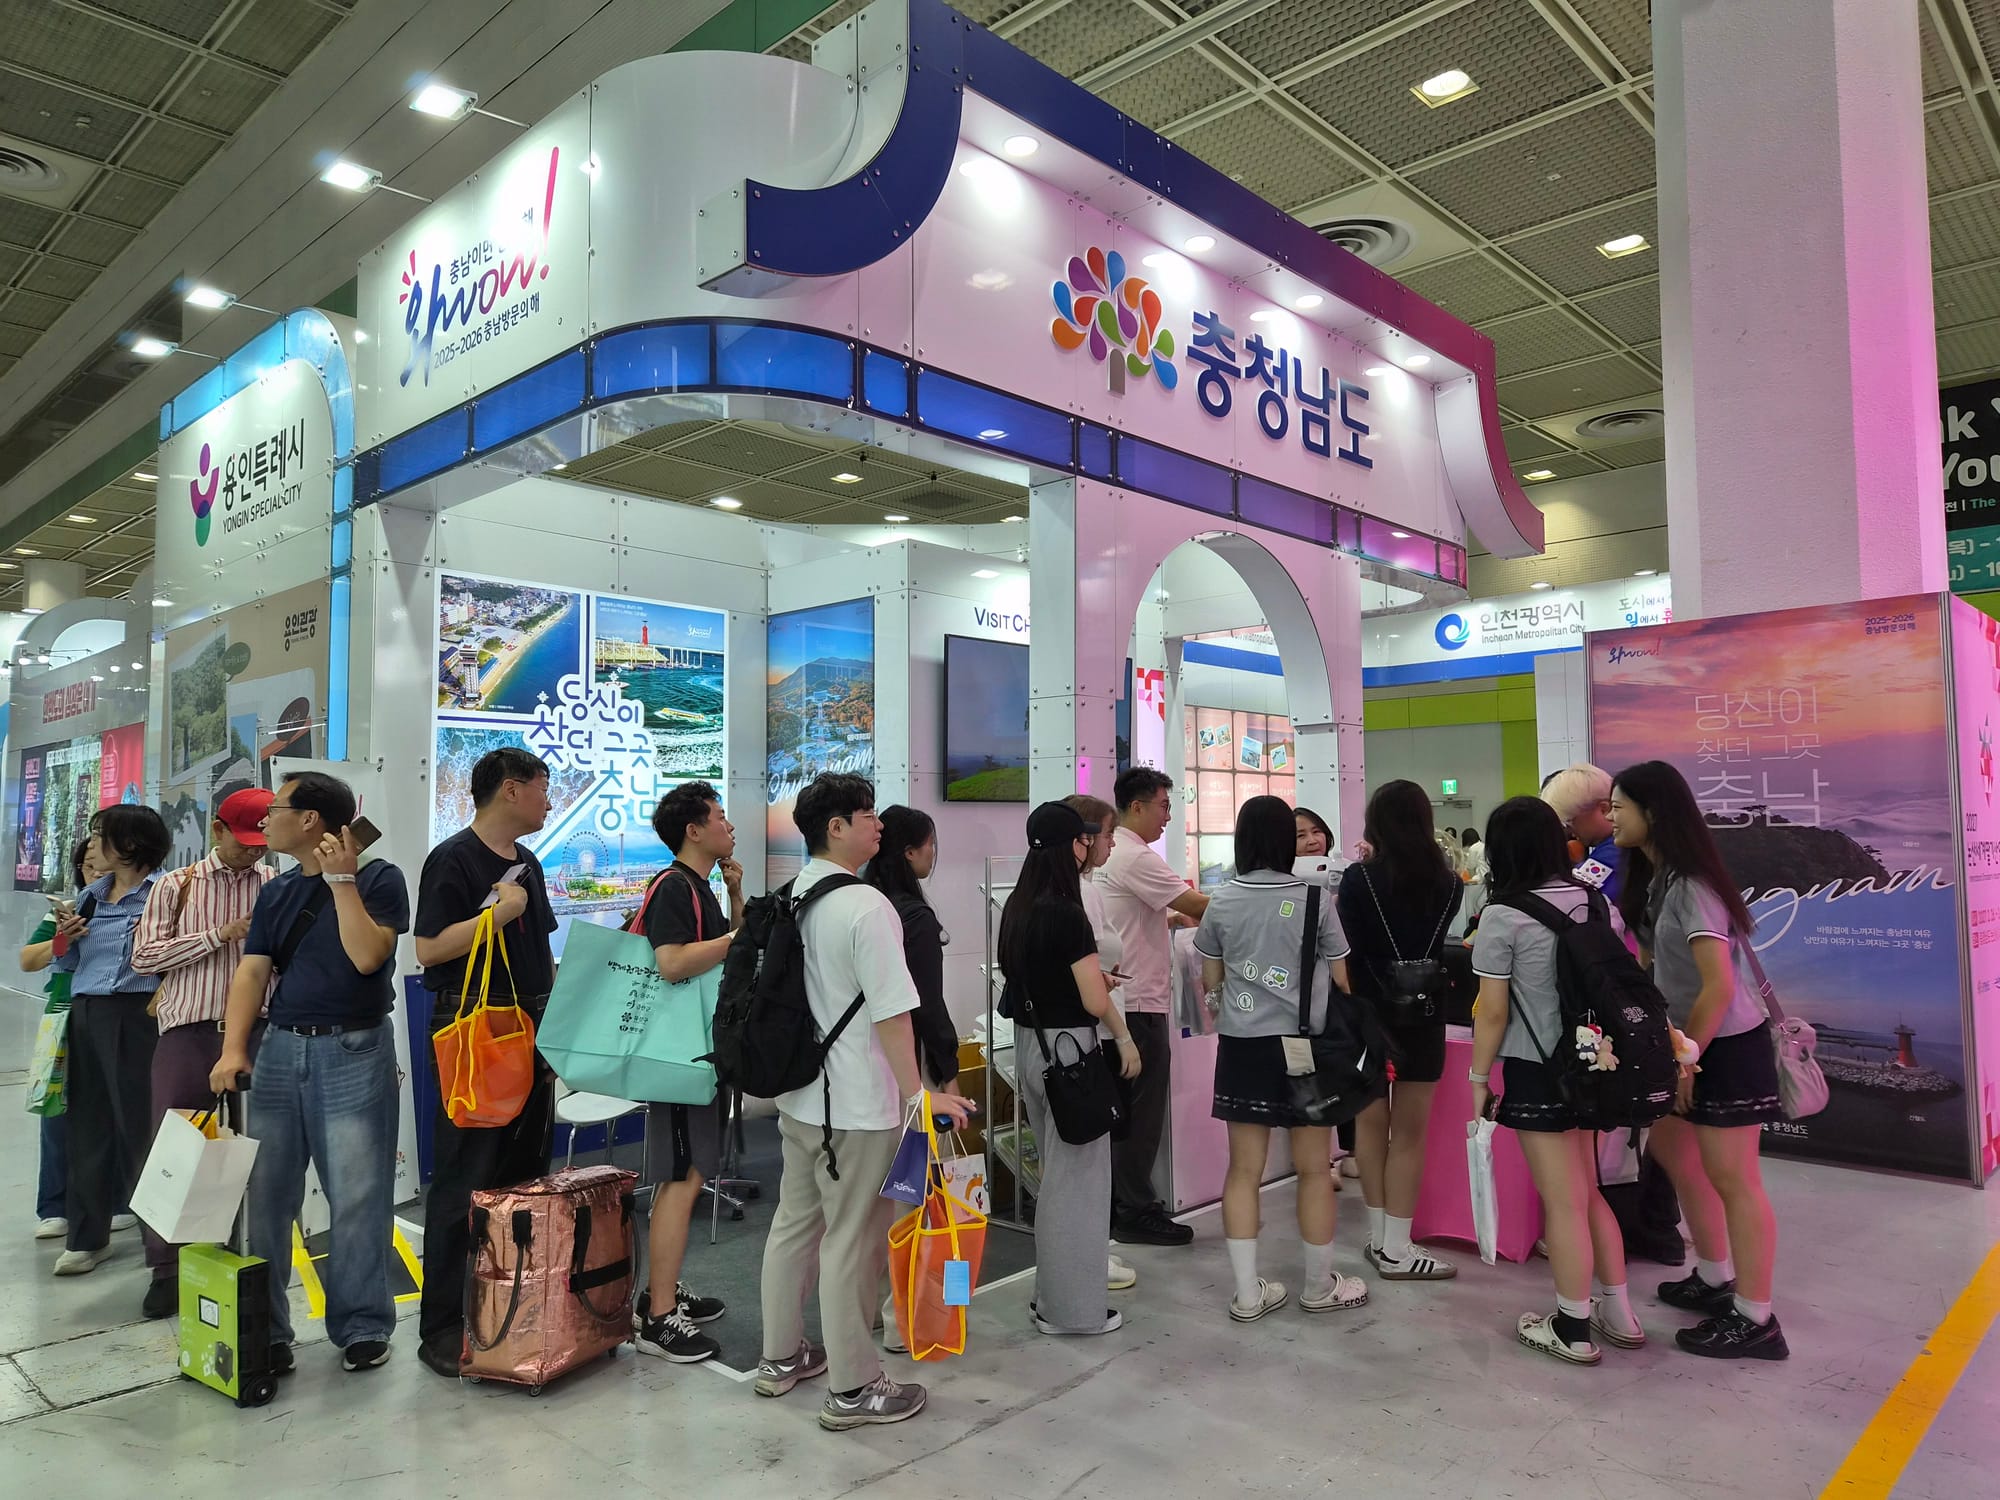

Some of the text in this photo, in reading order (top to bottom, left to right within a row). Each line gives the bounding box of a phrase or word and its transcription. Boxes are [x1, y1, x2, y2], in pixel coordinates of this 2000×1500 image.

[434, 327, 483, 369] 2025-2026
[1184, 310, 1374, 469] 충청남도
[223, 418, 304, 511] 용인특례시
[223, 482, 303, 534] YONGIN SPECIAL CITY
[1970, 498, 1996, 509] The
[1480, 600, 1584, 632] 인천광역시
[1481, 614, 1586, 644] Incheon Metropolitan City
[1865, 613, 1915, 626] 2025-2026
[563, 680, 639, 723] 당신이
[1694, 685, 1818, 731] 당신이
[528, 710, 653, 768] 찾던 그곳
[1695, 732, 1822, 765] 찾던 그곳
[597, 759, 677, 831] 충남
[1694, 767, 1831, 830] 충남
[1851, 926, 1884, 937] 느껴지는
[1772, 1121, 1808, 1135] 충청남도
